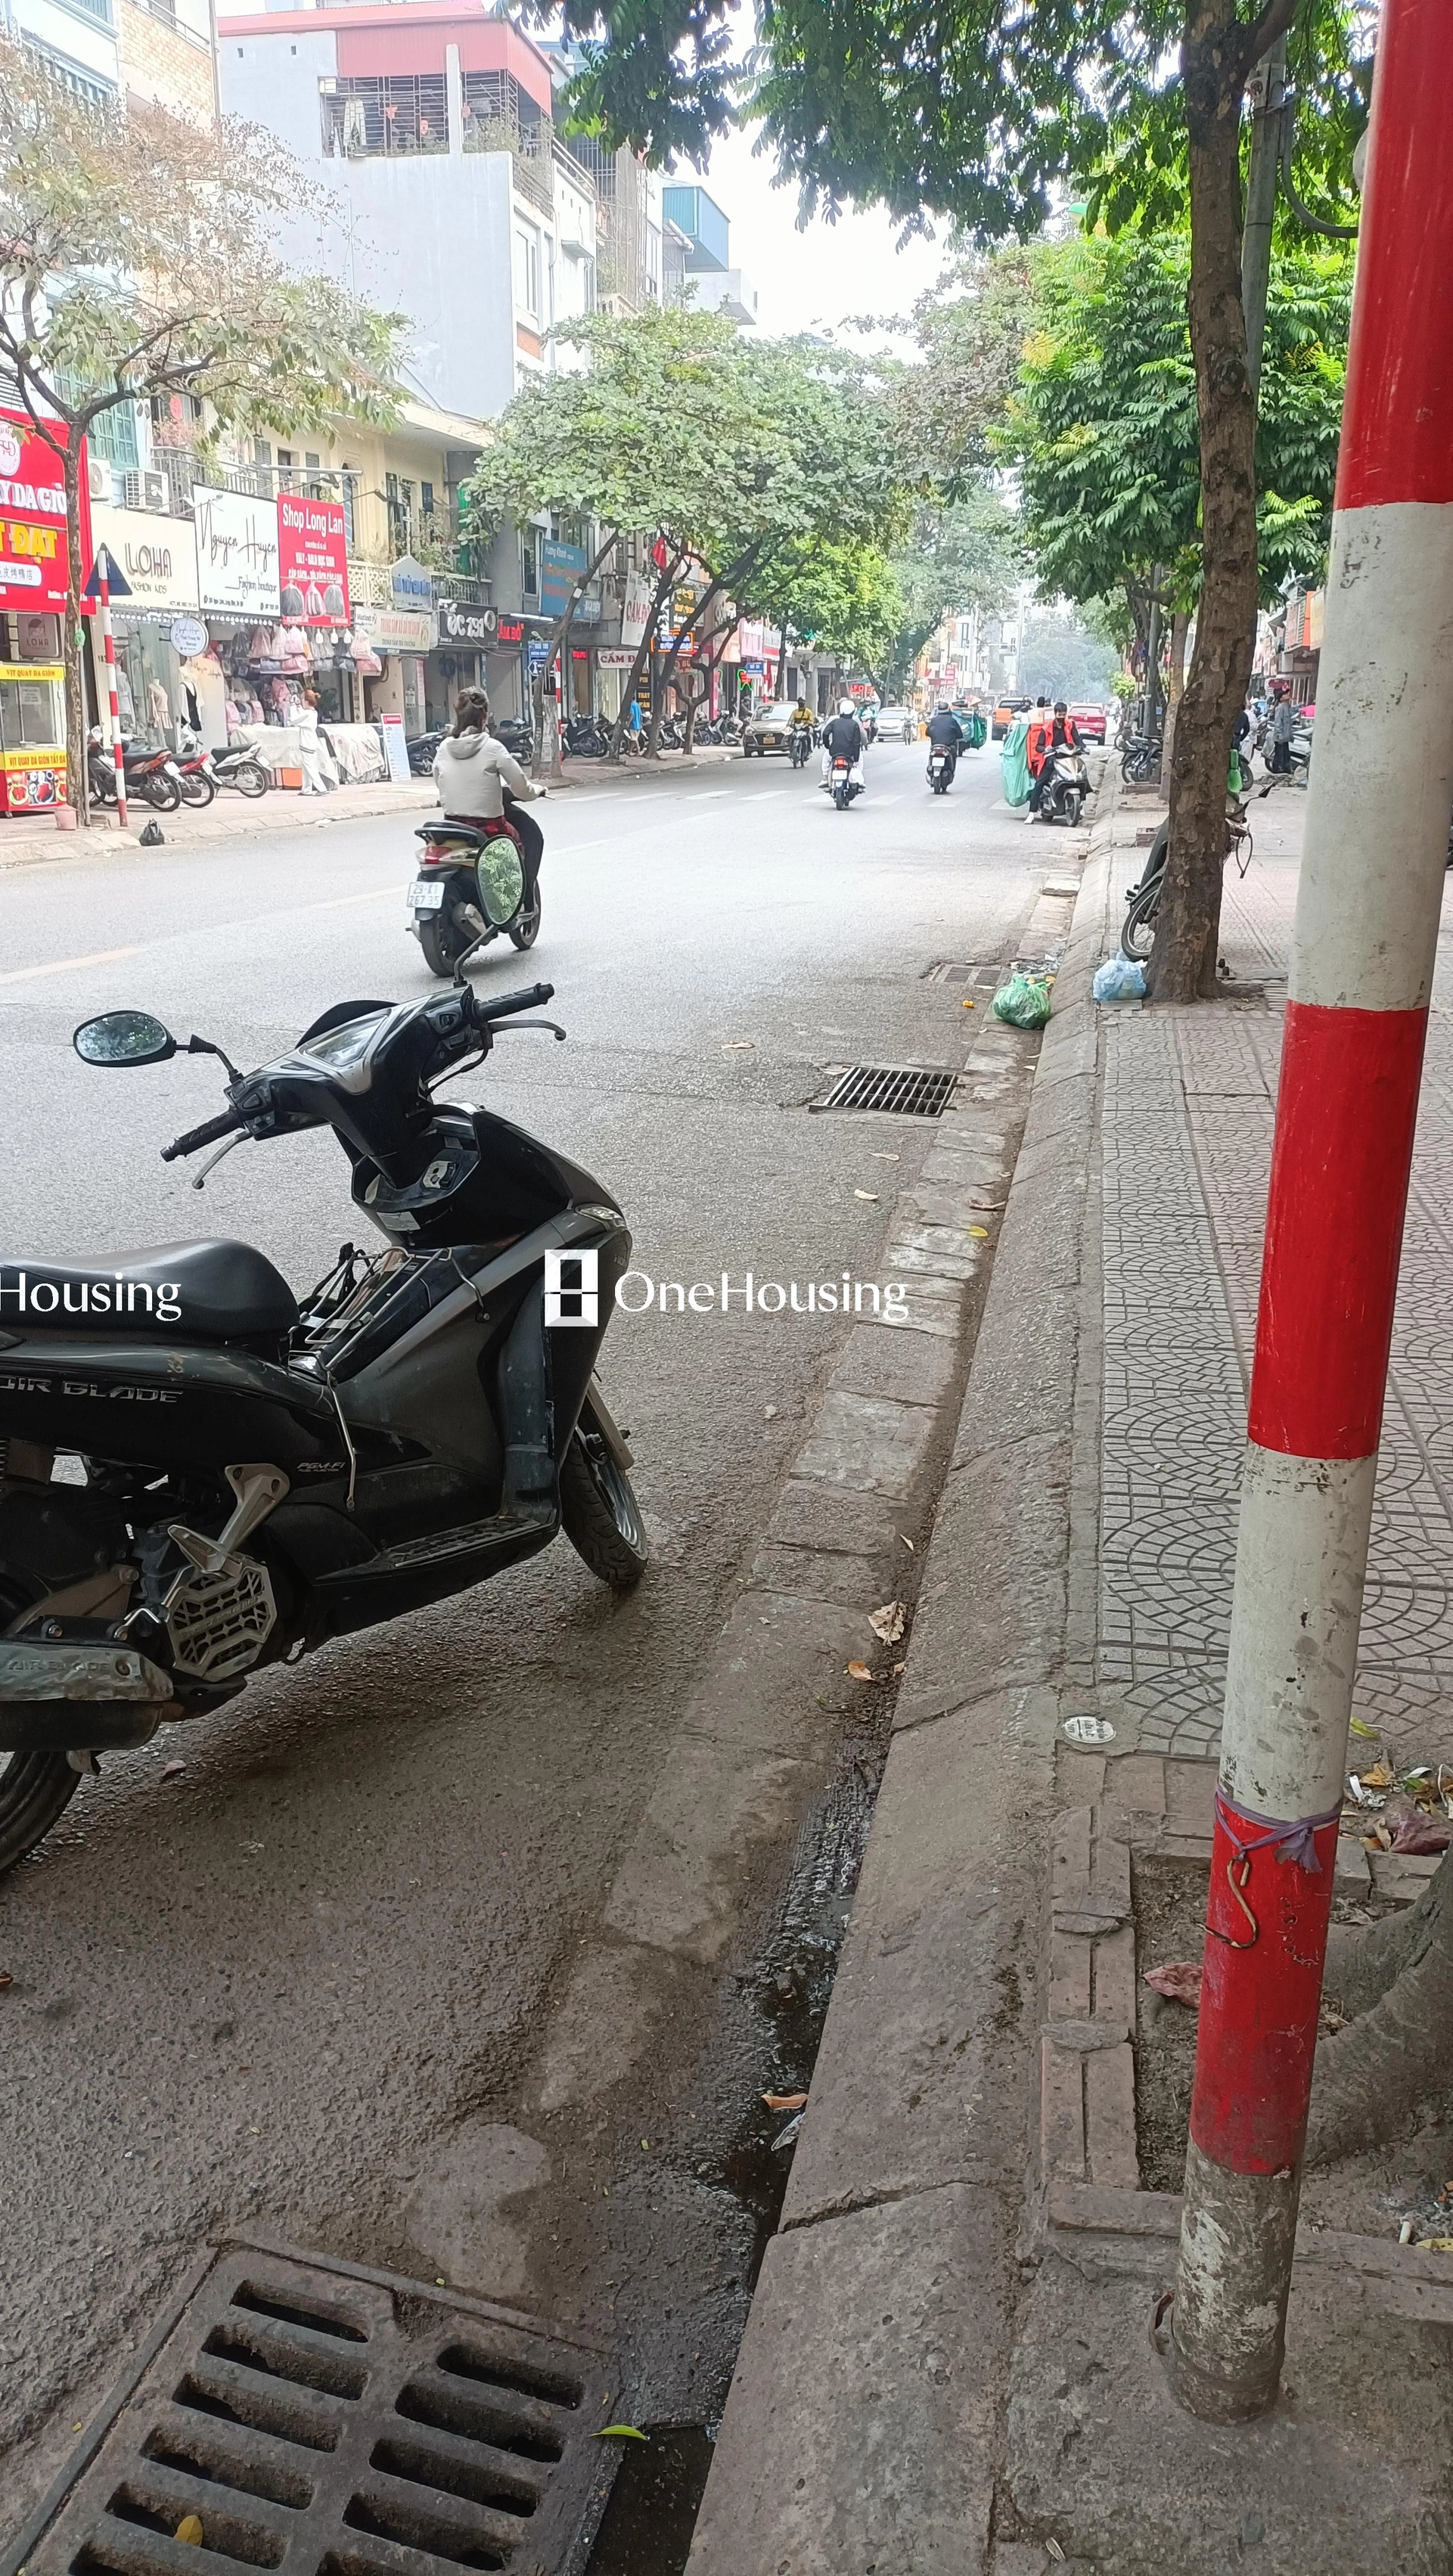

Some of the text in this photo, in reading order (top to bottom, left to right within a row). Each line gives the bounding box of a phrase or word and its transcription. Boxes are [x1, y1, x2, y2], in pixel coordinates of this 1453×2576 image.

[36, 483, 67, 514] GIÒ
[282, 503, 343, 538] Shop Long Lan
[9, 523, 57, 564] ĐẠT
[125, 542, 172, 578] LOHA
[466, 616, 484, 638] 191
[627, 655, 636, 663] Đ
[63, 1380, 184, 1403] BLADE
